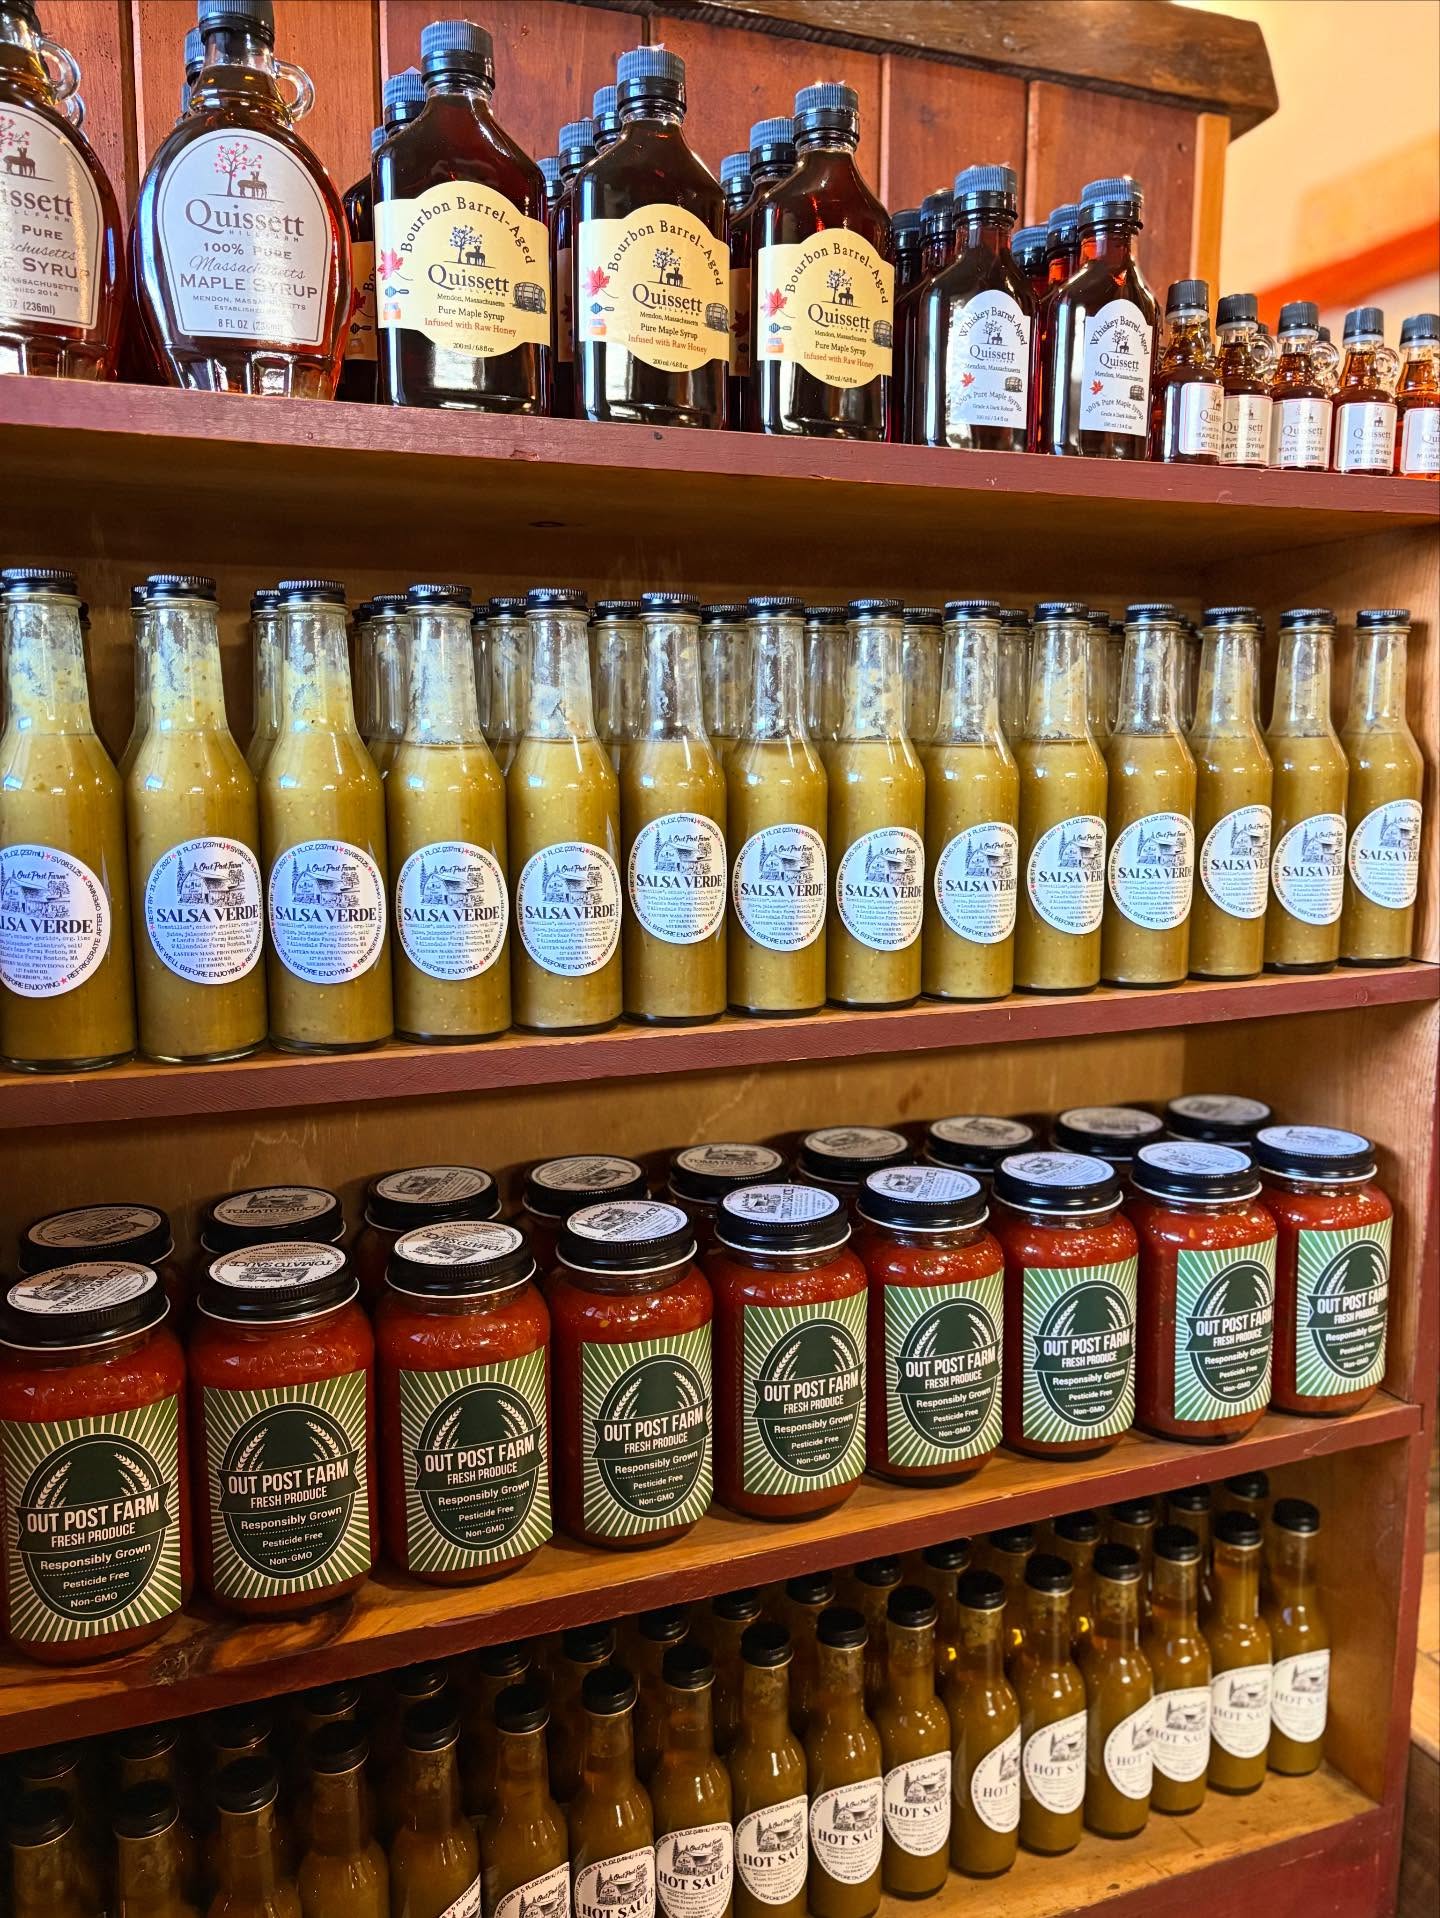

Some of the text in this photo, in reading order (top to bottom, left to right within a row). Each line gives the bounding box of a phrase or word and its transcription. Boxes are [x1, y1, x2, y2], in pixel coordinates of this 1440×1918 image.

[185, 199, 304, 236] Quissett
[22, 224, 63, 240] PURE
[400, 197, 535, 264] Bourbon Barrel-Aged
[204, 243, 244, 255] 100%
[608, 220, 723, 286] Bourbon Barrel-Aged
[181, 274, 246, 290] MAPLE
[428, 264, 509, 292] Quissett
[786, 243, 888, 304] Bourbon Barrel-Aged
[633, 284, 702, 312] Quissett
[439, 306, 505, 322] Pure Maple Syrup
[808, 303, 870, 329] Quissett
[959, 309, 989, 337] Whiskey
[218, 319, 223, 328] 8
[237, 320, 248, 329] OZ
[425, 318, 517, 338] Infused with Raw Honey
[641, 323, 698, 341] Pure Maple Syrup
[1090, 318, 1118, 345] Whiskey
[629, 333, 707, 355] Infused with Raw Honey
[970, 345, 1015, 362] Quissett
[1100, 353, 1139, 369] Quissett
[1360, 850, 1400, 860] SALSA
[1118, 867, 1160, 879] SALSA
[1211, 860, 1250, 870] SALSA
[1282, 866, 1322, 877] SALSA
[17, 870, 31, 879] Out
[32, 872, 46, 880] Post
[636, 874, 722, 888] SALSA VERDE
[1039, 871, 1081, 882] SALSA
[741, 884, 823, 896] SALSA VERDE
[846, 884, 889, 898] SALSA
[946, 881, 991, 892] SALSA
[156, 904, 259, 922] SALSA VERDE
[276, 906, 376, 922] SALSA VERDE
[404, 906, 500, 922] SALSA VERDE
[526, 904, 614, 919] SALSA VERDE
[30, 919, 93, 934] VERDE
[67, 938, 101, 980] REFRIGERATE
[1317, 1298, 1341, 1314] OUT
[1343, 1293, 1367, 1311] POST
[1334, 1305, 1379, 1325] FRESH PRODUCE
[1196, 1320, 1220, 1336] OUT
[1222, 1315, 1248, 1334] POST
[1044, 1329, 1130, 1356] OUT POST FARM
[1213, 1328, 1262, 1347] FRESH PRODUCE
[906, 1346, 996, 1377] OUT POST FARM
[1062, 1351, 1117, 1368] FRESH PRODUCE
[764, 1370, 859, 1402] OUT POST FARM
[925, 1370, 982, 1389] FRESH PRODUCE
[784, 1395, 844, 1414] FRESH PRODUCE
[916, 1387, 991, 1408] Responsibly Grown
[604, 1406, 703, 1441] OUT POST FARM
[774, 1413, 853, 1434] Responsibly Grown
[625, 1432, 688, 1454] FRESH PRODUCE
[791, 1435, 839, 1449] Pesticide Free
[425, 1434, 535, 1473] OUT POST FARM
[615, 1450, 698, 1474] Responsibly Grown
[797, 1452, 830, 1464] Non-GMO
[228, 1458, 349, 1495] OUT POST FARM
[447, 1462, 518, 1485] FRESH PRODUCE
[634, 1474, 683, 1490] Pesticide Free
[251, 1486, 328, 1509] FRESH PRODUCE
[438, 1479, 529, 1506] Responsibly Grown
[639, 1492, 675, 1505] Non-GMO
[27, 1492, 160, 1533] OUT POST FARM
[241, 1506, 342, 1531] Responsibly Grown
[459, 1506, 514, 1522] Pesticide Free
[51, 1521, 136, 1548] FRESH PRODUCE
[263, 1531, 323, 1548] Pesticide Free
[466, 1523, 505, 1538] Non-GMO
[41, 1543, 151, 1573] Responsibly Grown
[270, 1551, 313, 1565] Non-GMO
[63, 1571, 130, 1590] Pesticide Free
[71, 1591, 118, 1608] Non-GMO
[1034, 1764, 1061, 1776] HOT
[890, 1803, 918, 1818] HOT
[818, 1829, 846, 1846] HOT
[743, 1854, 774, 1868] HOT
[660, 1870, 688, 1889] HOT
[583, 1904, 613, 1918] HOT
